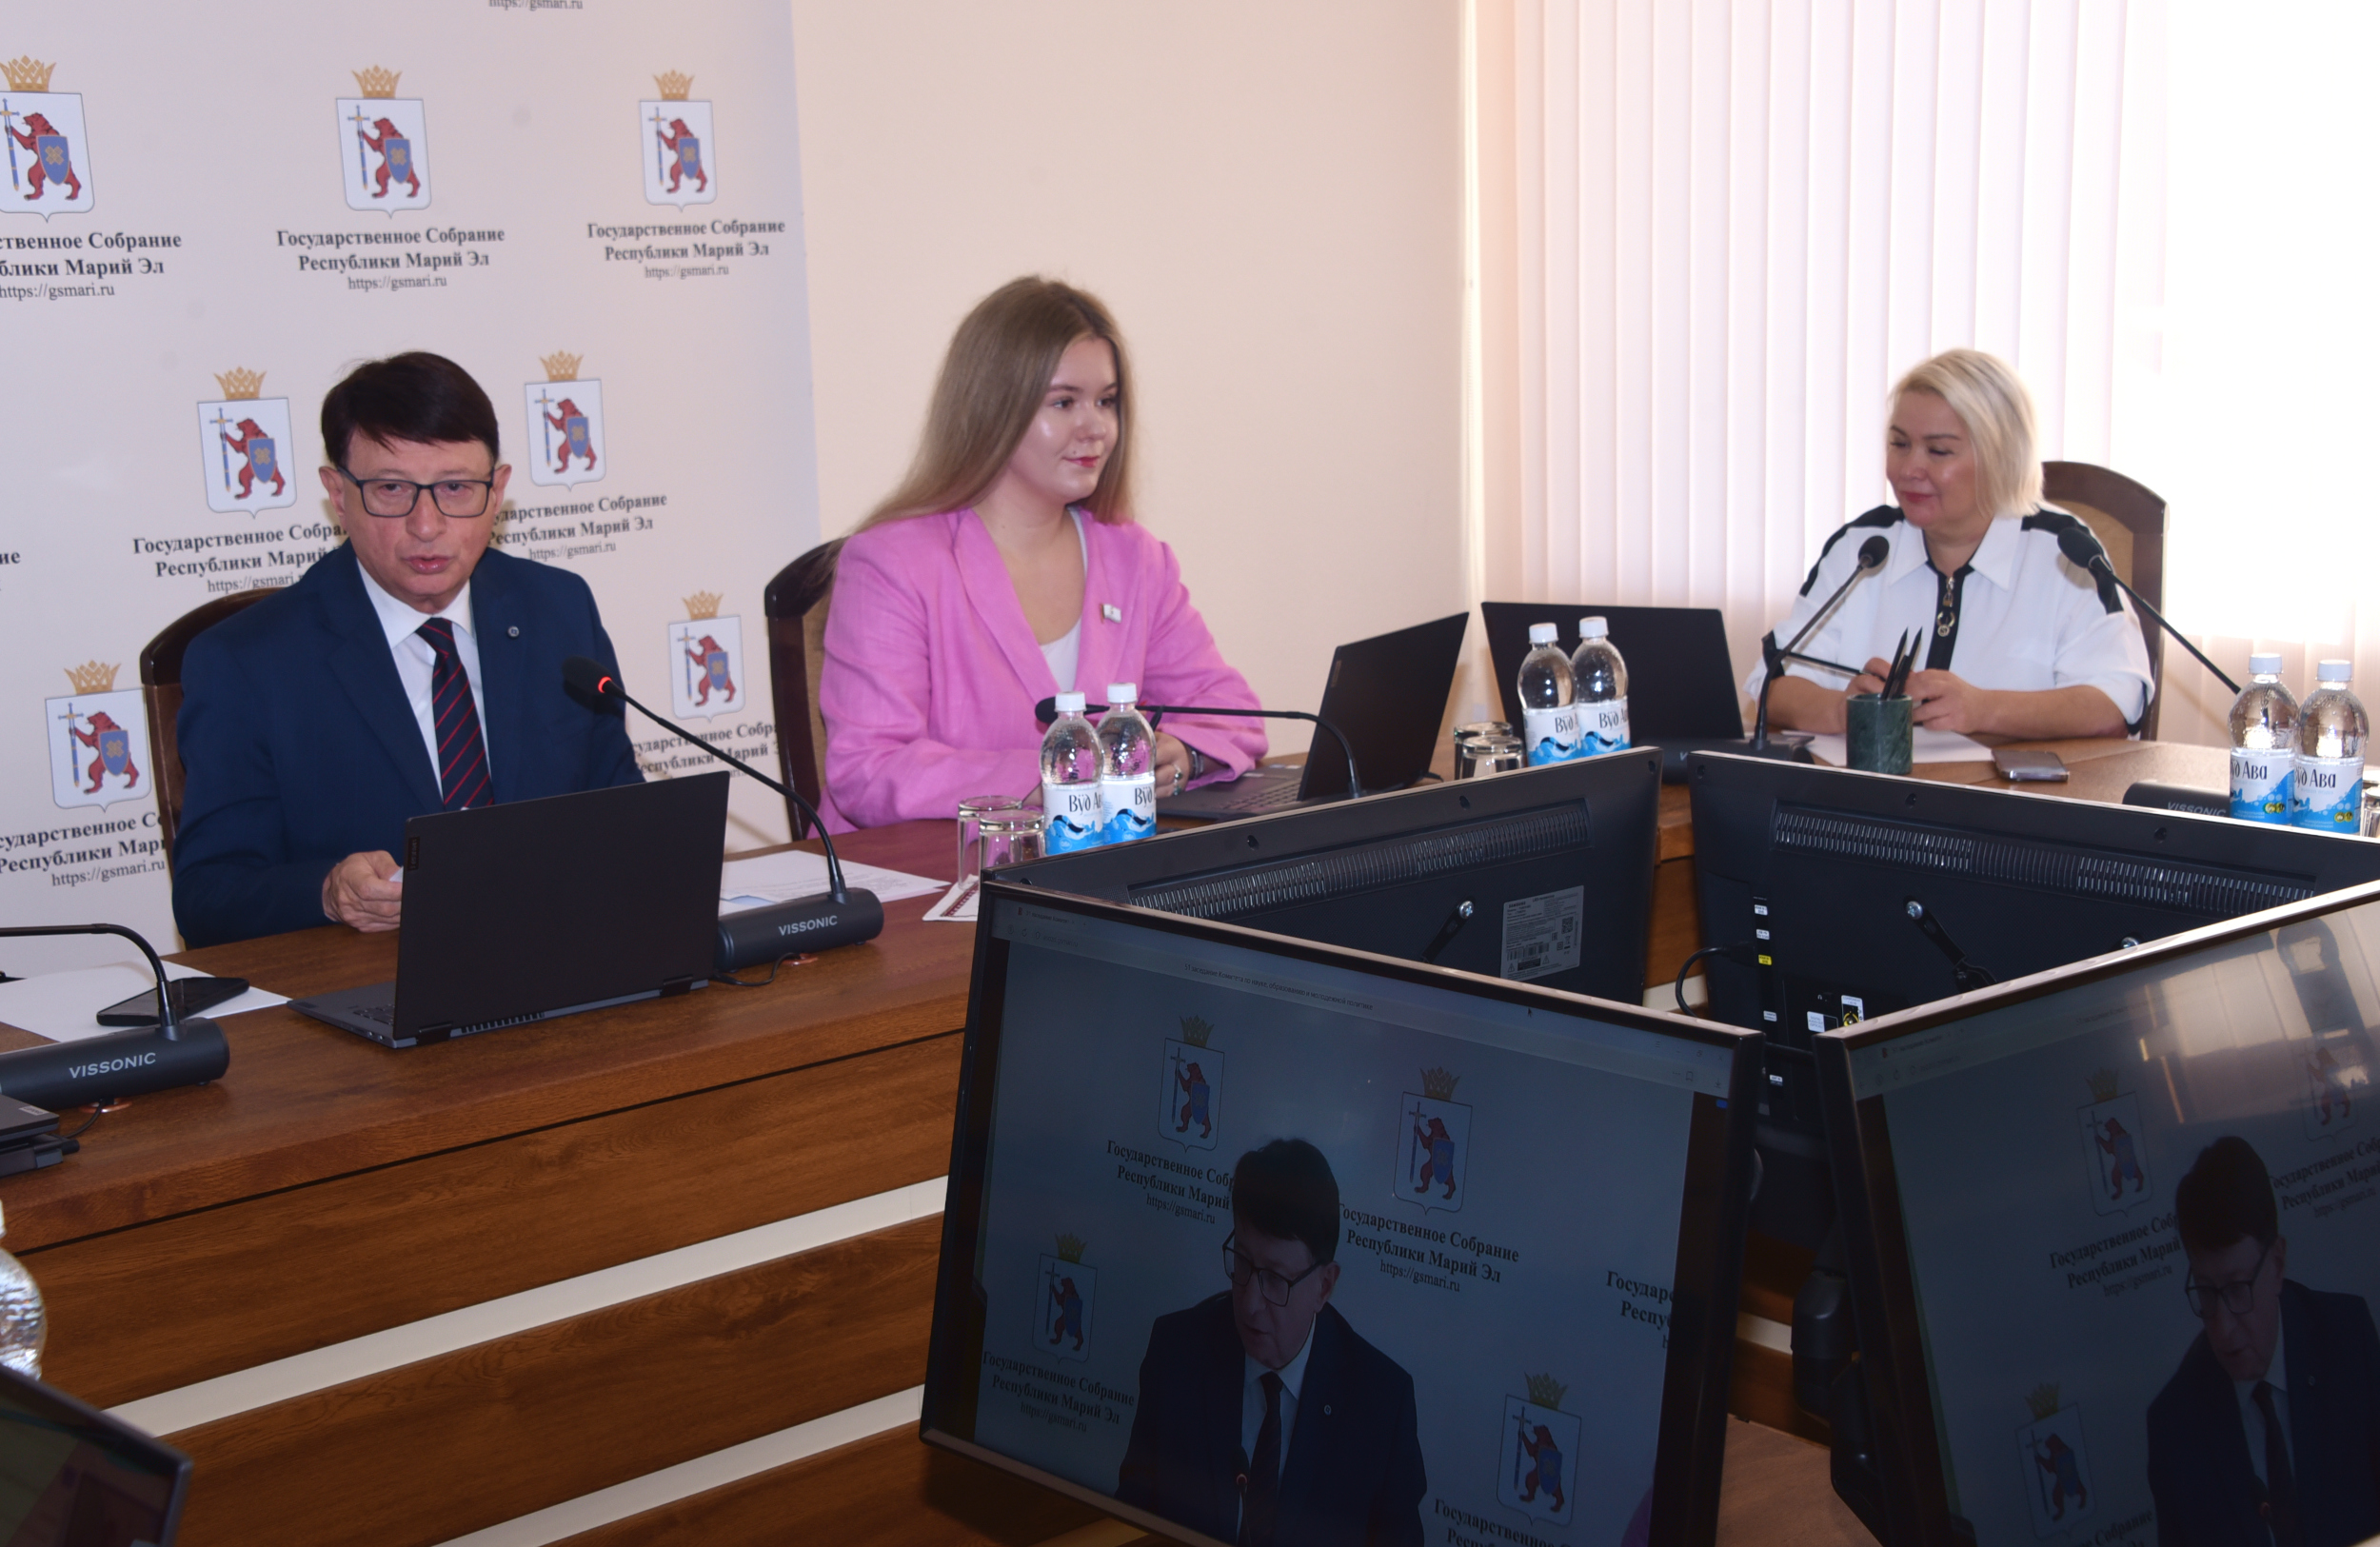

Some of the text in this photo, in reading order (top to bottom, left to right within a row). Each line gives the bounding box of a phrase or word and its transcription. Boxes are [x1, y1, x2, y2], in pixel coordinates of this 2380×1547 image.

[89, 231, 183, 252] Собрание
[276, 226, 506, 250] Государственное Собрание
[586, 219, 785, 241] Государственное Собрание
[298, 250, 489, 274] Республики Марий Эл
[604, 241, 769, 263] Республики Марий Эл
[65, 258, 133, 280] Марий
[139, 258, 165, 275] Эл
[347, 274, 447, 290] https://gsmari.ru
[645, 265, 729, 280] https://gsmari.ru
[598, 495, 668, 513] Собрание
[581, 519, 630, 538] Марий
[634, 517, 654, 532] Эл
[132, 528, 285, 555] Государственное
[155, 553, 263, 579] Республики
[637, 754, 715, 776] еспублики
[51, 860, 166, 887] https://gsmari.ru
[779, 915, 838, 936] VISSONIC
[69, 1051, 156, 1080] VISSONIC
[1106, 1140, 1203, 1180] Государственное
[1117, 1164, 1230, 1210] Республики Марий
[1146, 1192, 1216, 1225] https://gsmari.ru
[1346, 1228, 1501, 1283] Республики Марий Эл
[1449, 1231, 1519, 1262] Собрание
[2049, 1224, 2150, 1269] Государственное
[2067, 1235, 2182, 1289] Республики Марий
[1379, 1259, 1460, 1293] https://gsmari.ru
[982, 1350, 1135, 1406] Государственное Собрание
[992, 1374, 1121, 1425] Республики Марий Эл
